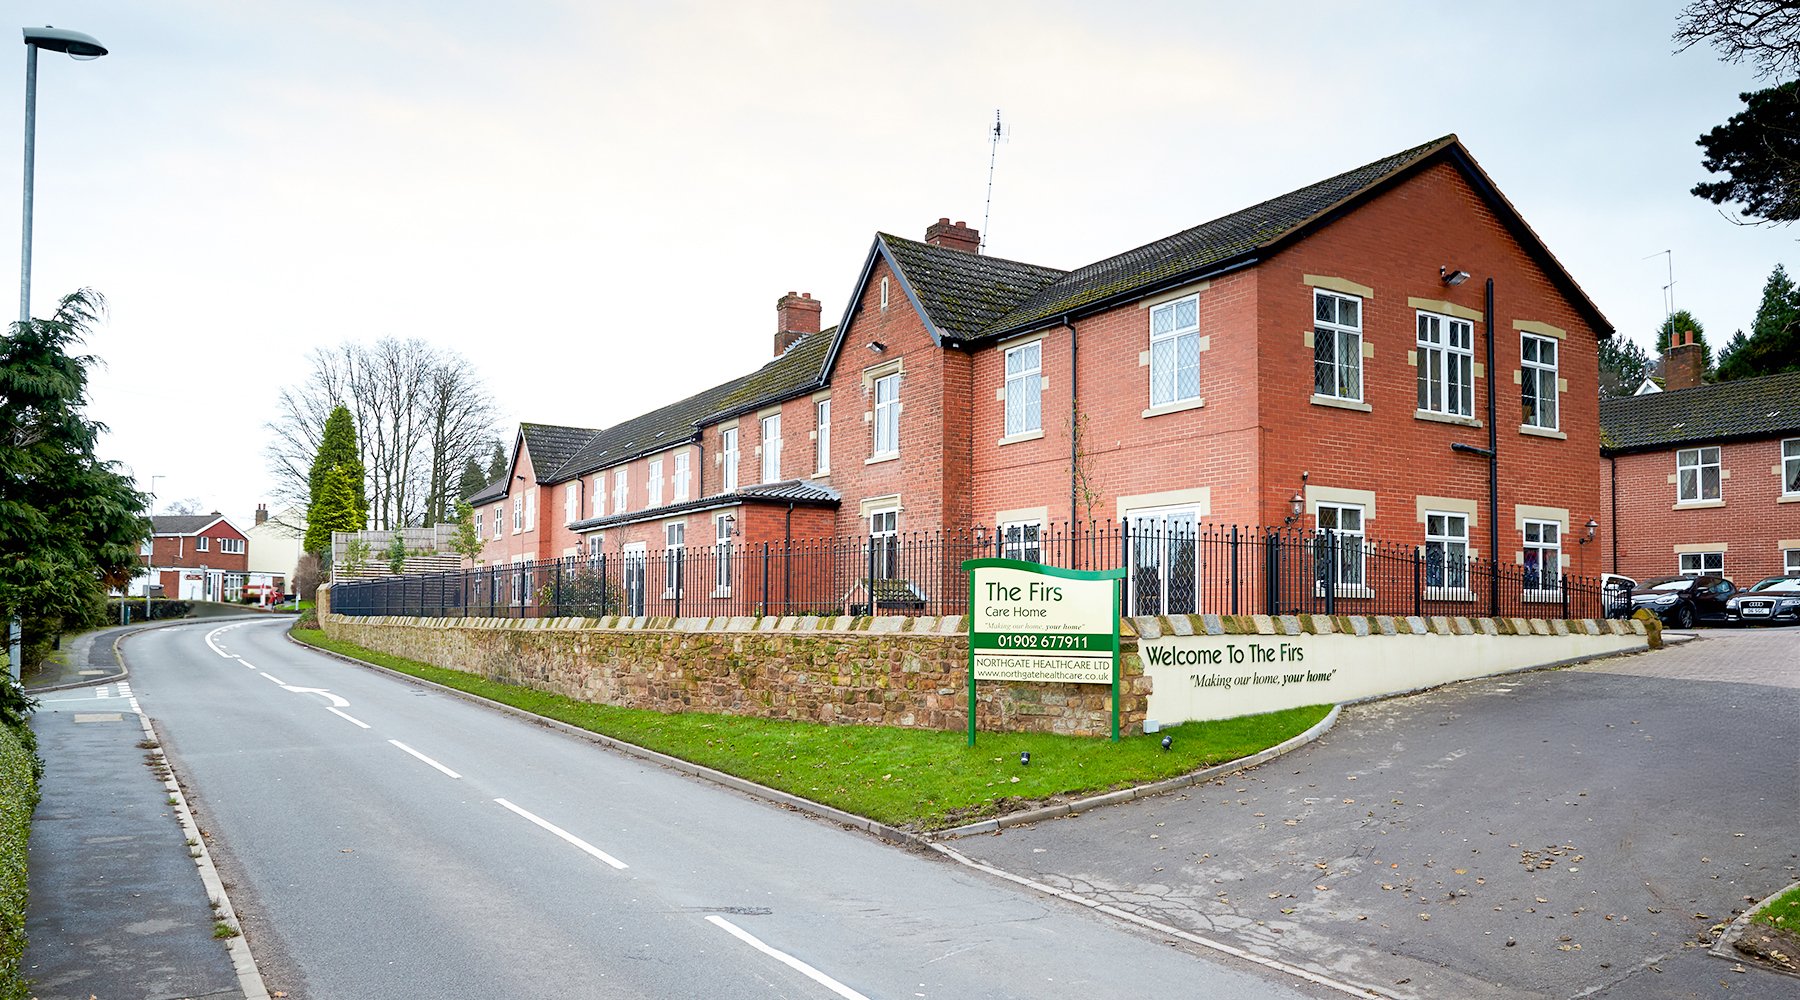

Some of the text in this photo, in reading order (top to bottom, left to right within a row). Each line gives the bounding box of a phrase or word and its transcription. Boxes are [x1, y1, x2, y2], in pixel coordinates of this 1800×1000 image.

[985, 582, 1063, 602] The Firs
[985, 606, 1047, 618] Care Home
[997, 634, 1088, 649] 01902 677911
[1146, 643, 1304, 666] Welcome To The Firs
[976, 658, 1110, 670] NORTHGATE HEALTHCARE LTD
[977, 670, 1109, 681] www.northgatehealthcare.co.uk
[1190, 669, 1337, 690] "Making our home, your home"
